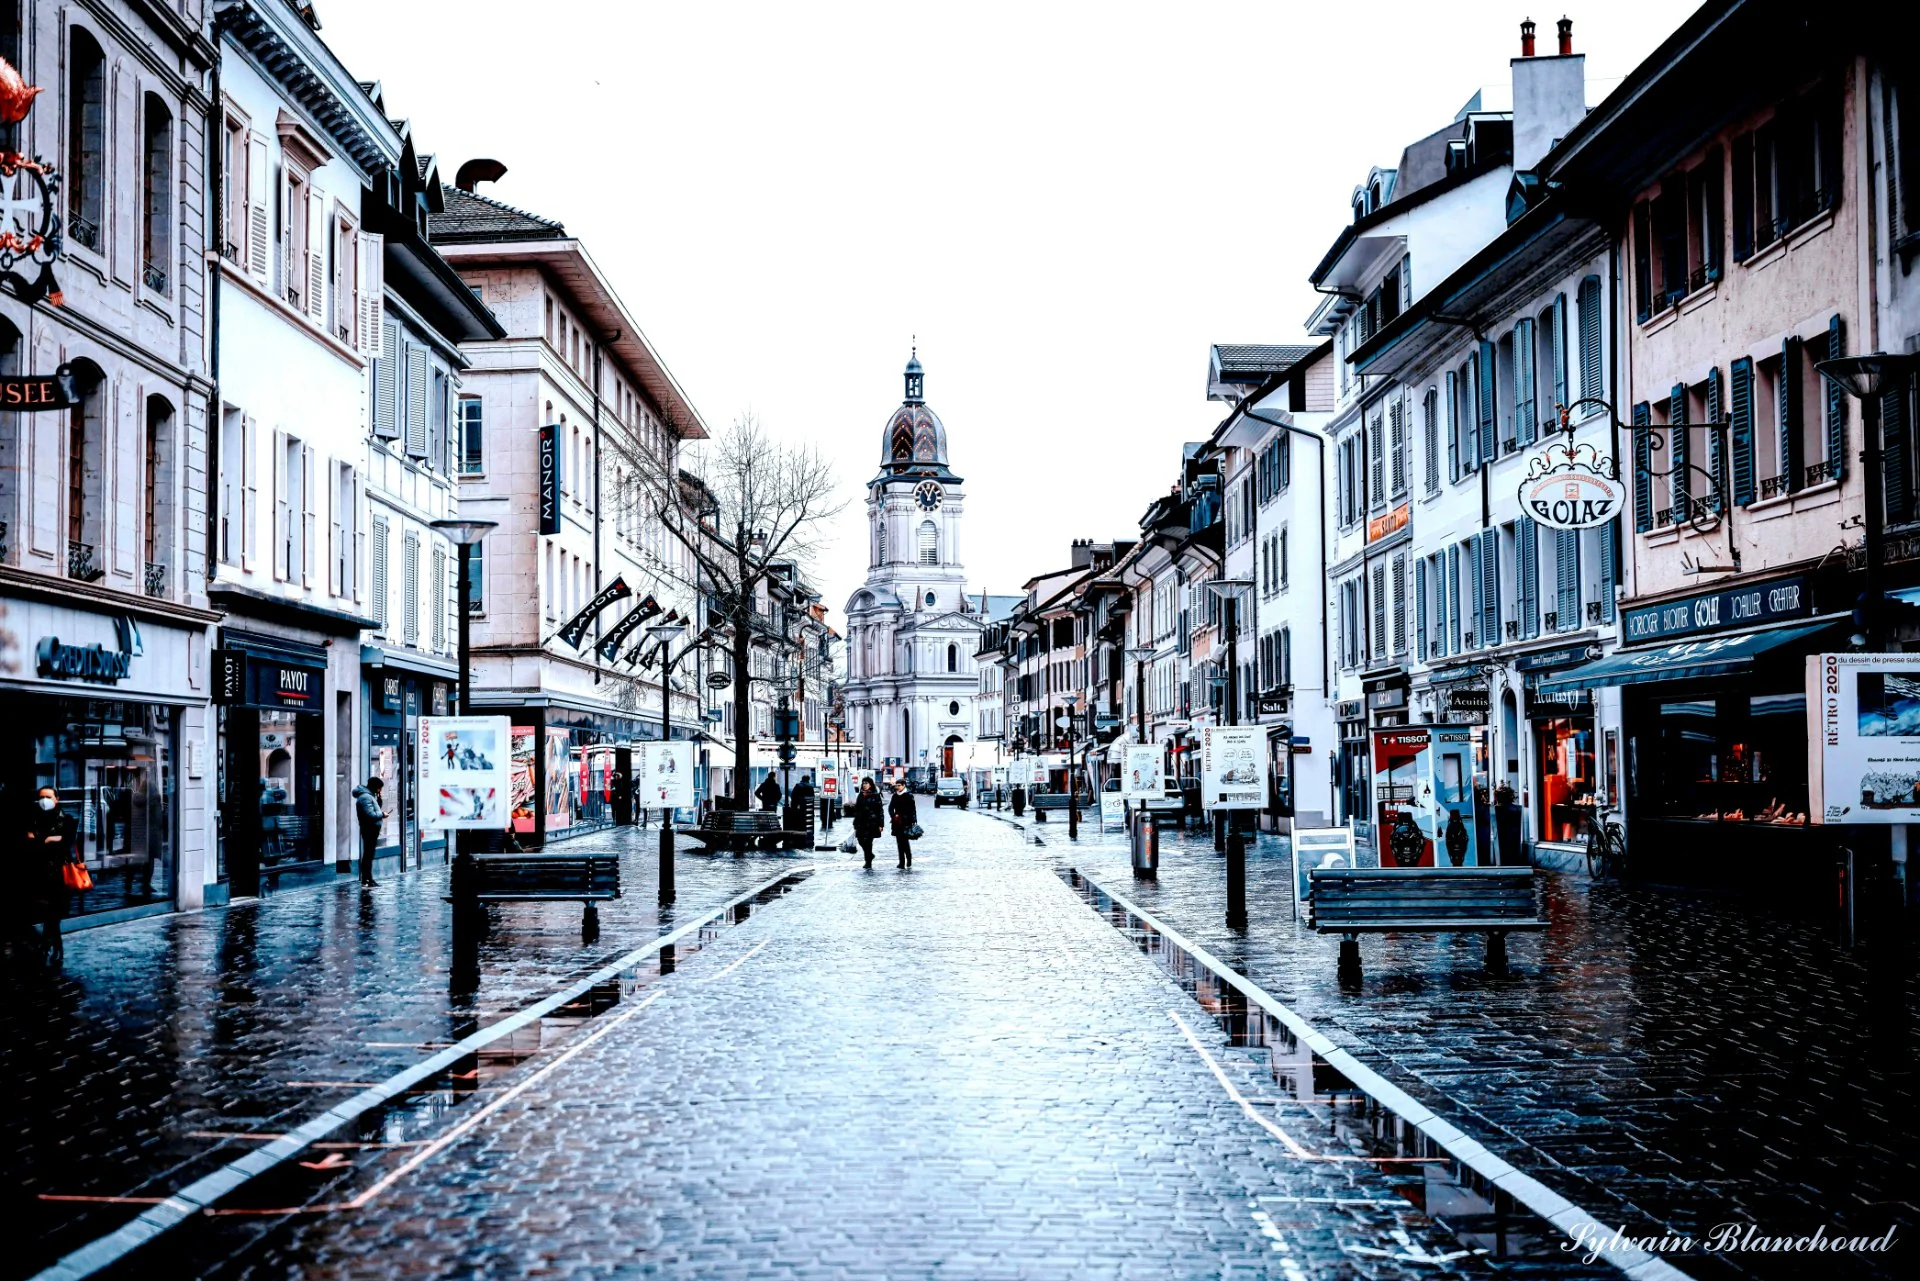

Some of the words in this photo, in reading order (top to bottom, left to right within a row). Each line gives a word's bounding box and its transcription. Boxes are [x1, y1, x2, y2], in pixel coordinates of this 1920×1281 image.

[0, 382, 56, 404] SEE
[542, 438, 553, 520] MANOR
[1530, 499, 1615, 525] GOLAZ
[567, 587, 619, 643] MANOR
[1694, 596, 1721, 628] GOLAZ
[602, 606, 651, 656] MANOR
[1838, 656, 1848, 664] du
[1848, 655, 1871, 664] dessin
[1871, 656, 1881, 664] de
[1882, 657, 1905, 665] presse
[225, 656, 233, 697] PAYOT
[280, 669, 308, 692] PAYOT
[1826, 655, 1838, 694] 2020
[1262, 702, 1285, 712] Salt.
[1454, 696, 1488, 706] Acuitis
[1825, 698, 1839, 746] RÉTRO
[1396, 735, 1429, 744] TISSOT
[1449, 733, 1470, 741] TISSOT
